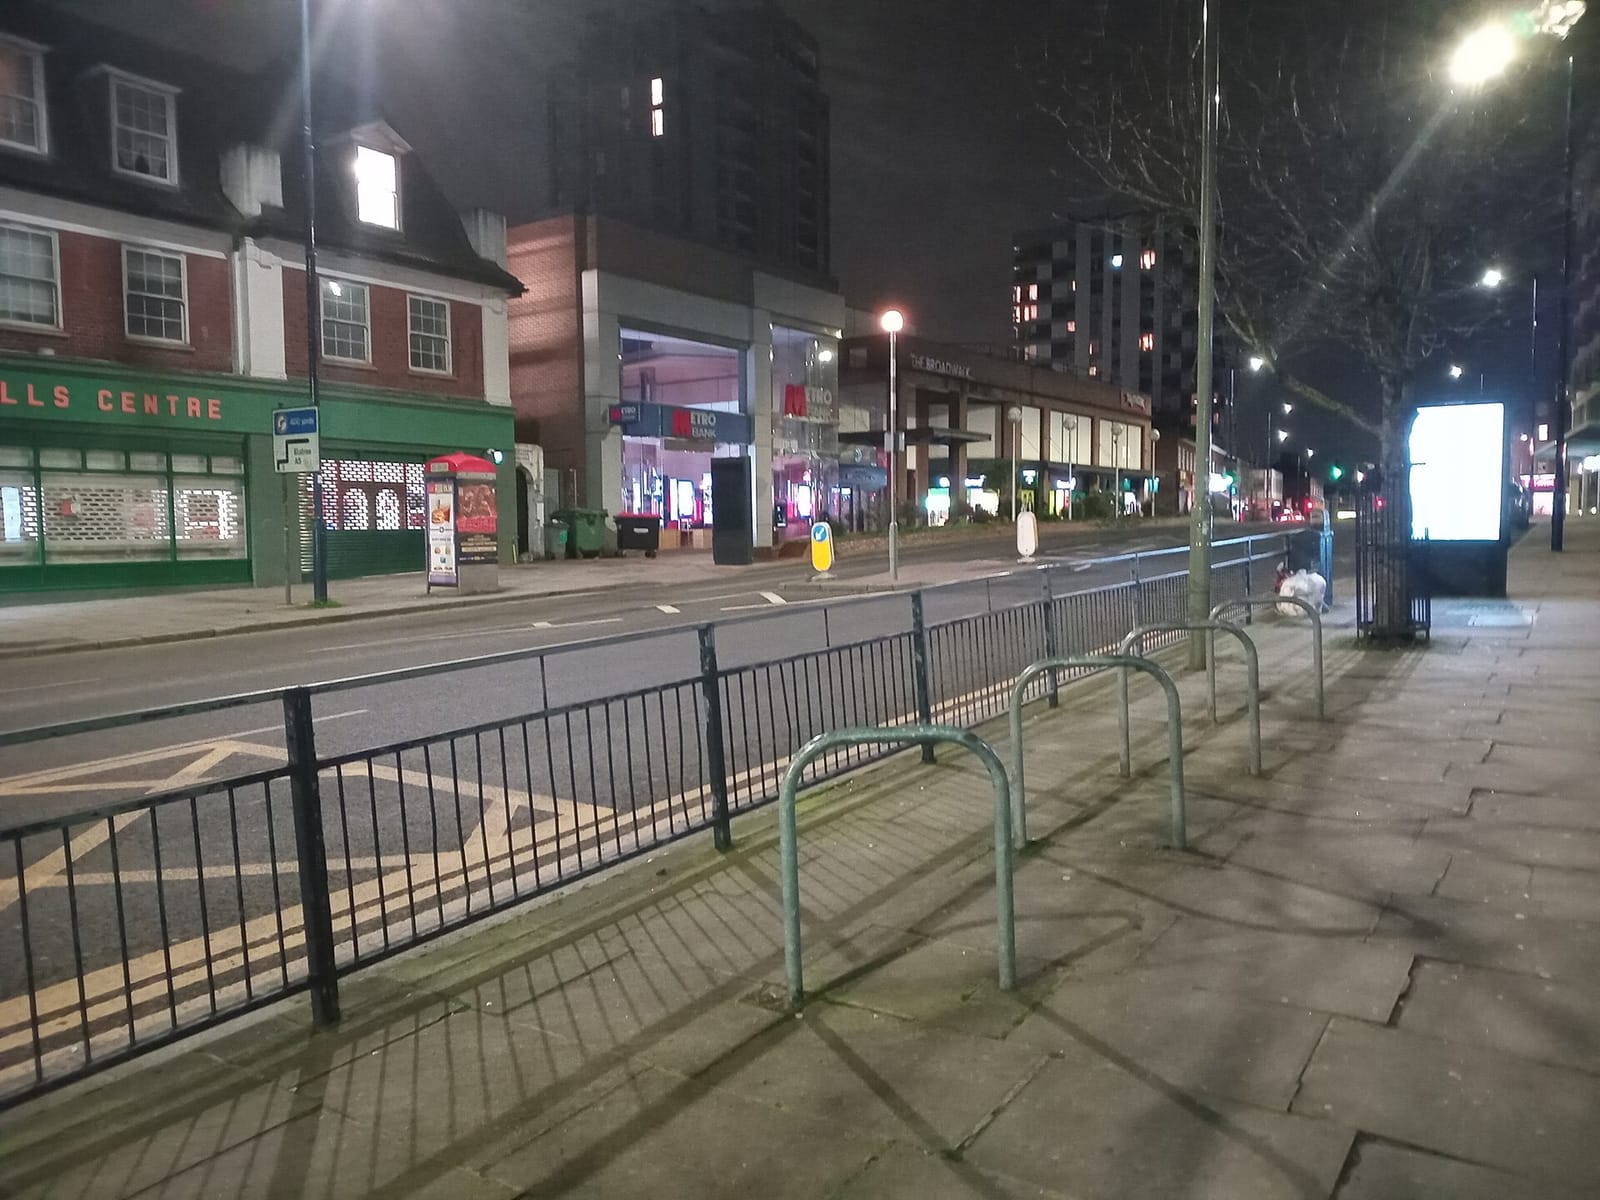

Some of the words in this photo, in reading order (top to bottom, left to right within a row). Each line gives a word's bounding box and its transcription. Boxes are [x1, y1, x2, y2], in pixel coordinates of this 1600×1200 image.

[97, 389, 222, 419] CENTRE
[672, 409, 716, 438] METRO
[692, 425, 717, 438] BANK
